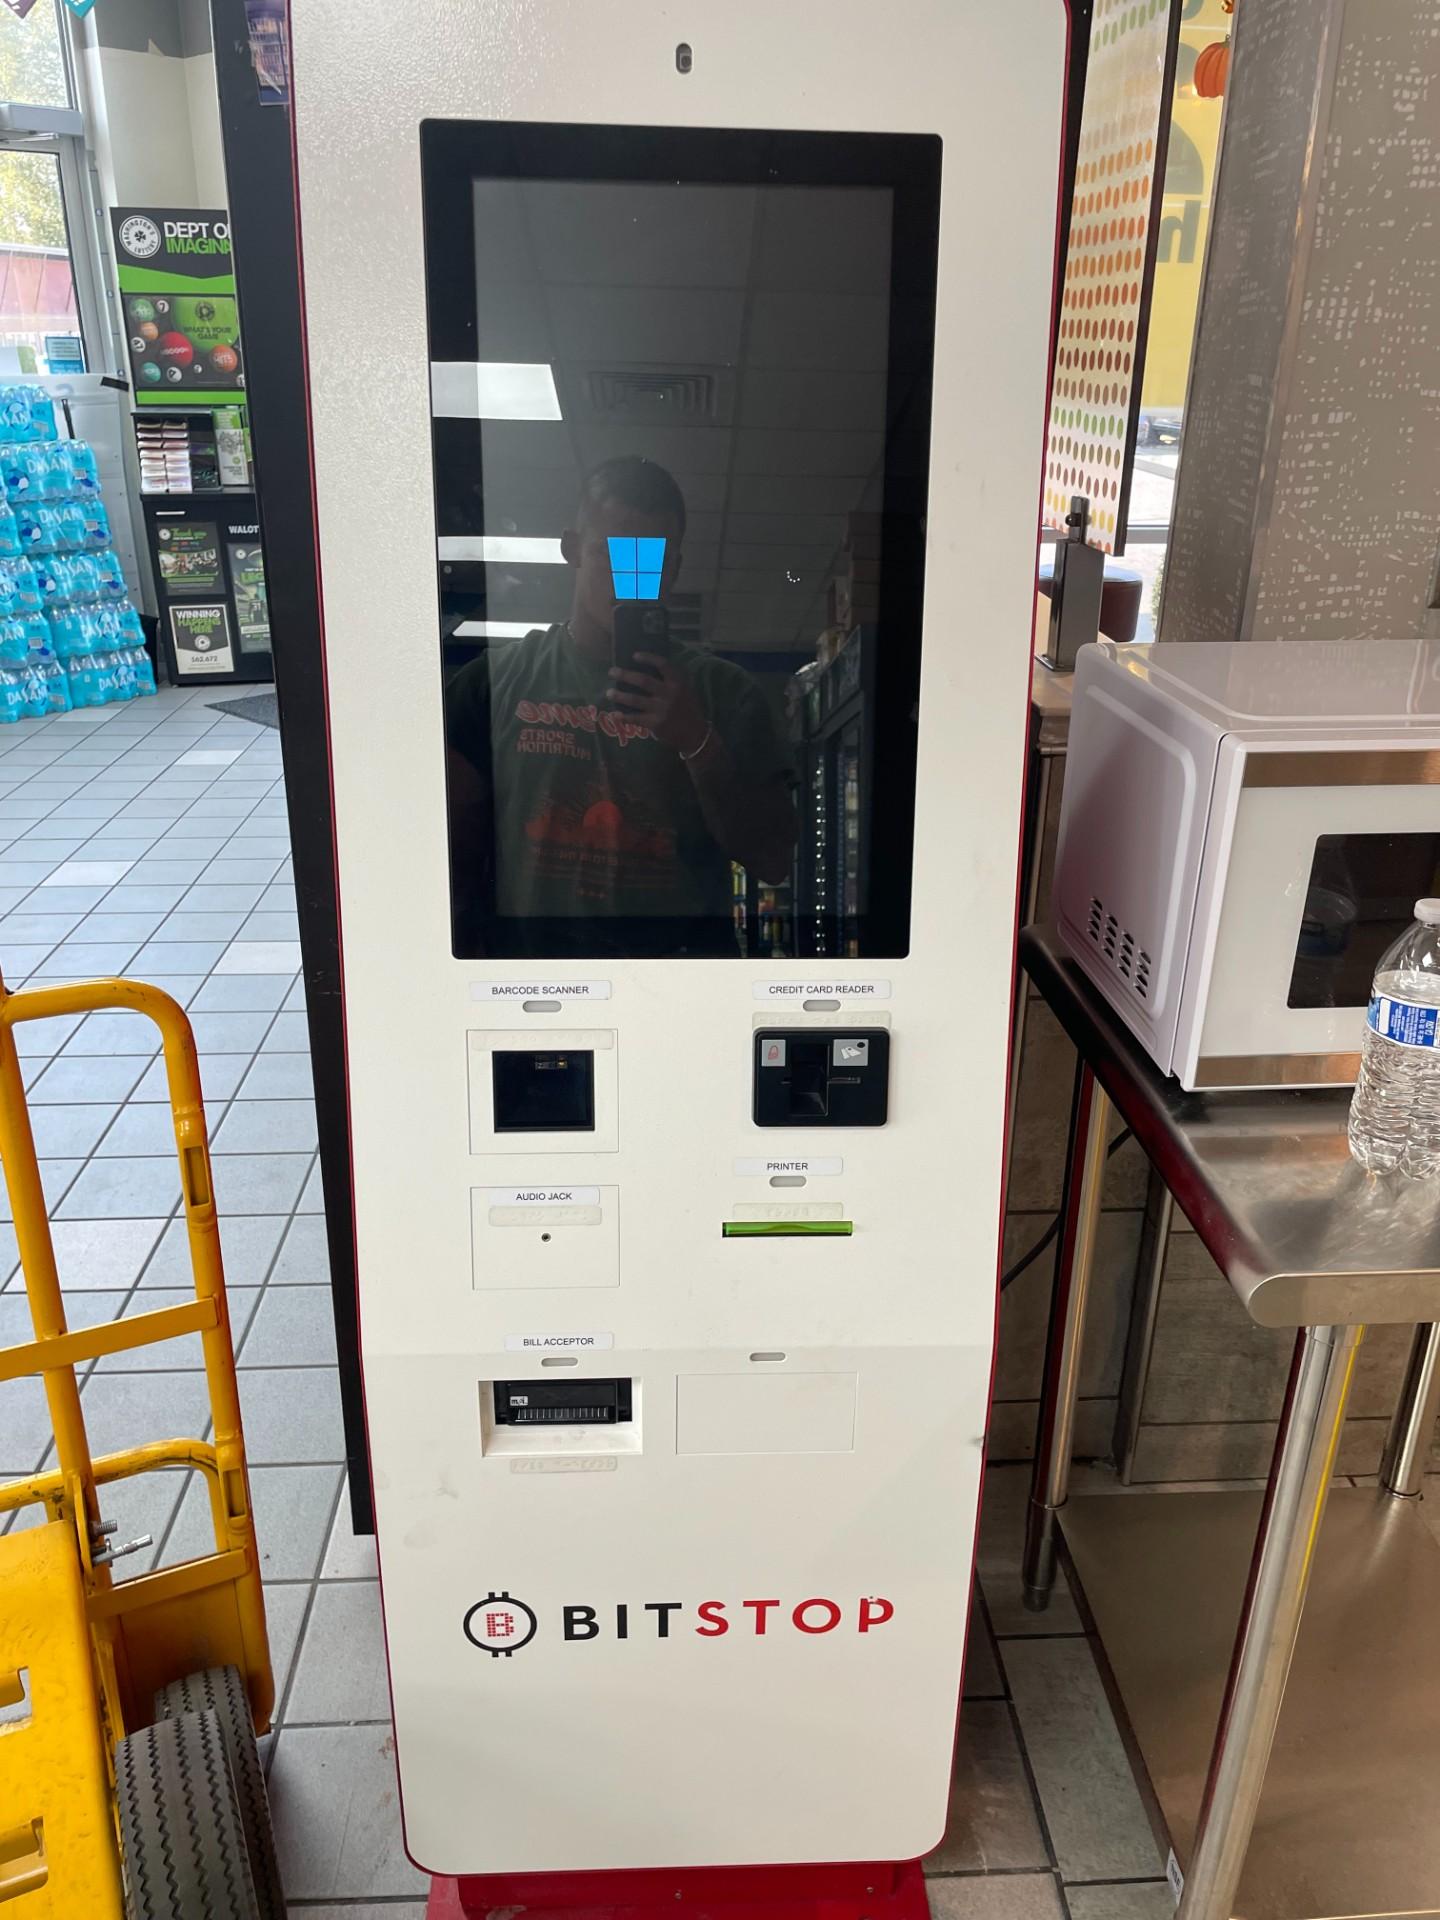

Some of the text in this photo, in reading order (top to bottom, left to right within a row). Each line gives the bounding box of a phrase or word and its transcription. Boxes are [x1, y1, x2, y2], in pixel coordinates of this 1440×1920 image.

[163, 221, 230, 239] DEPT O
[176, 609, 220, 618] WINNING
[491, 985, 590, 995] BARCODE SCANNER
[768, 985, 875, 994] CREDIT CARD READER
[766, 1162, 809, 1171] PRINTER
[515, 1192, 573, 1201] AUDIO JACK
[523, 1337, 595, 1347] BILL ACCEPTOR
[563, 1598, 894, 1641] BITSTOP
